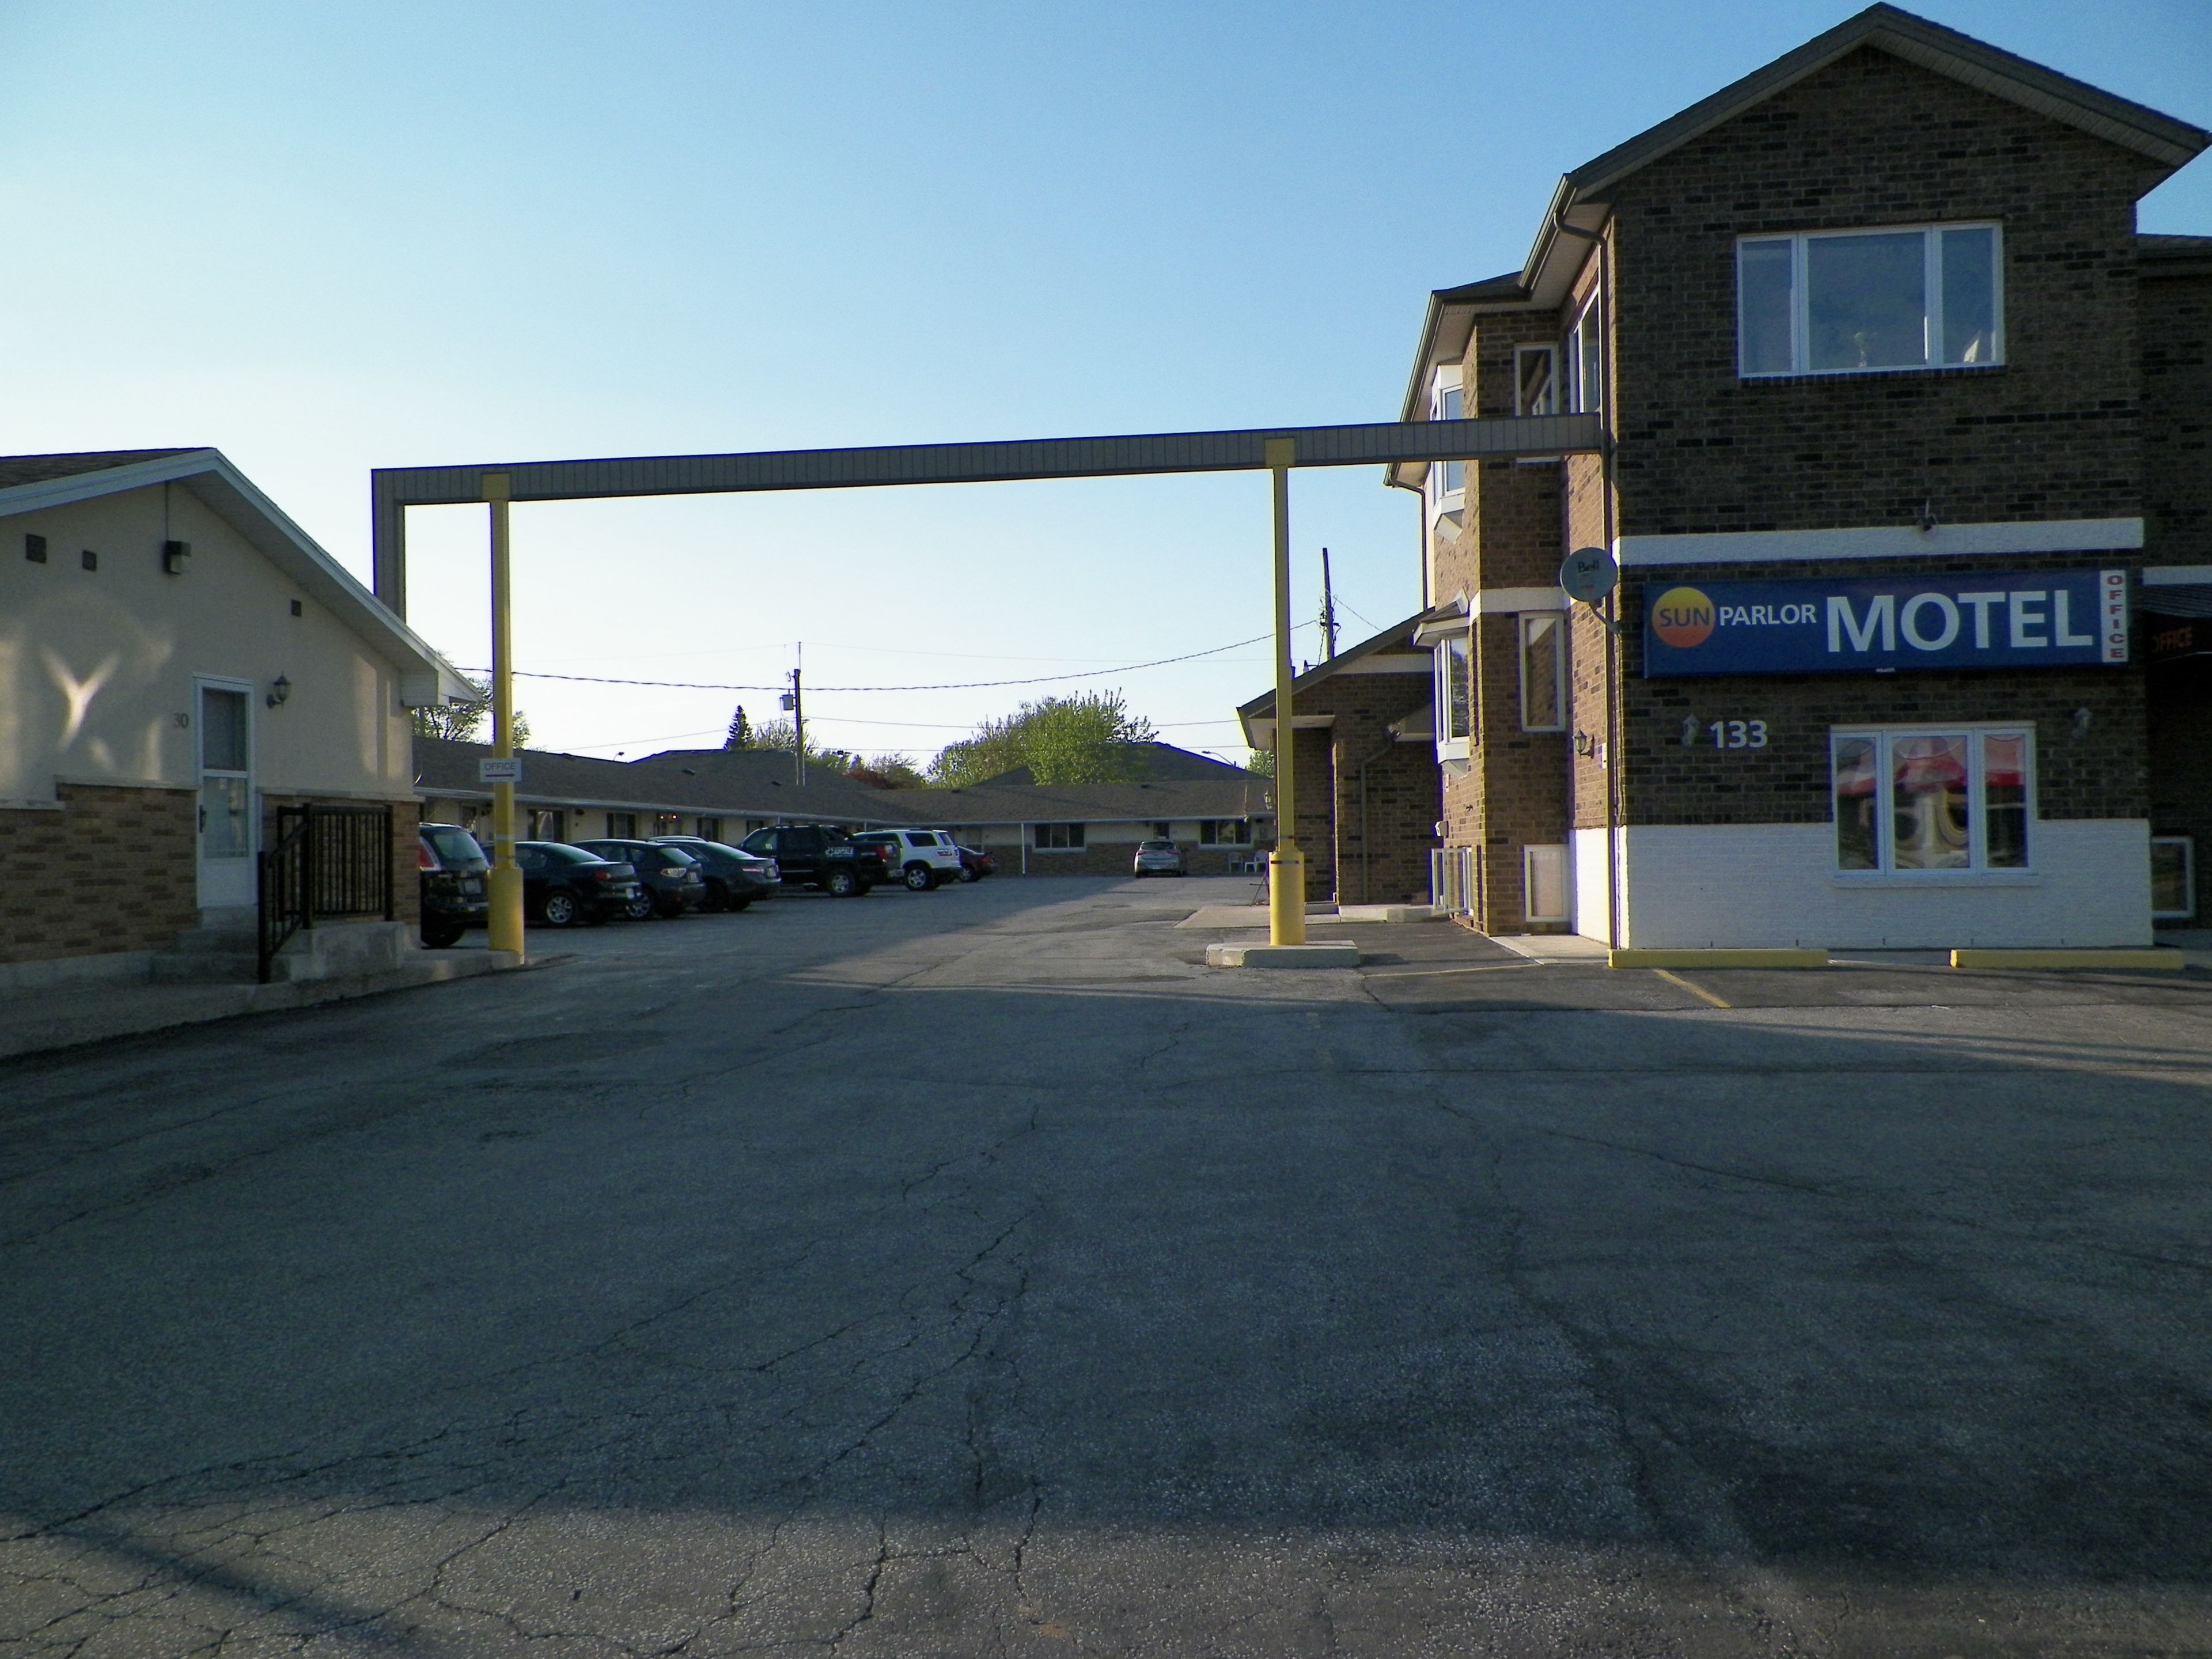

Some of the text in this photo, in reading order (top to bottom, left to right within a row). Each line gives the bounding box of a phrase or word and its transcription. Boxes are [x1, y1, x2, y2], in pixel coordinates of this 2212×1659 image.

[1578, 559, 1599, 573] Bell
[1659, 590, 2093, 652] SUN PARLOR MOTEL
[2107, 575, 2124, 658] OFFICE
[1710, 720, 1767, 748] 133
[484, 762, 516, 771] OFFICE
